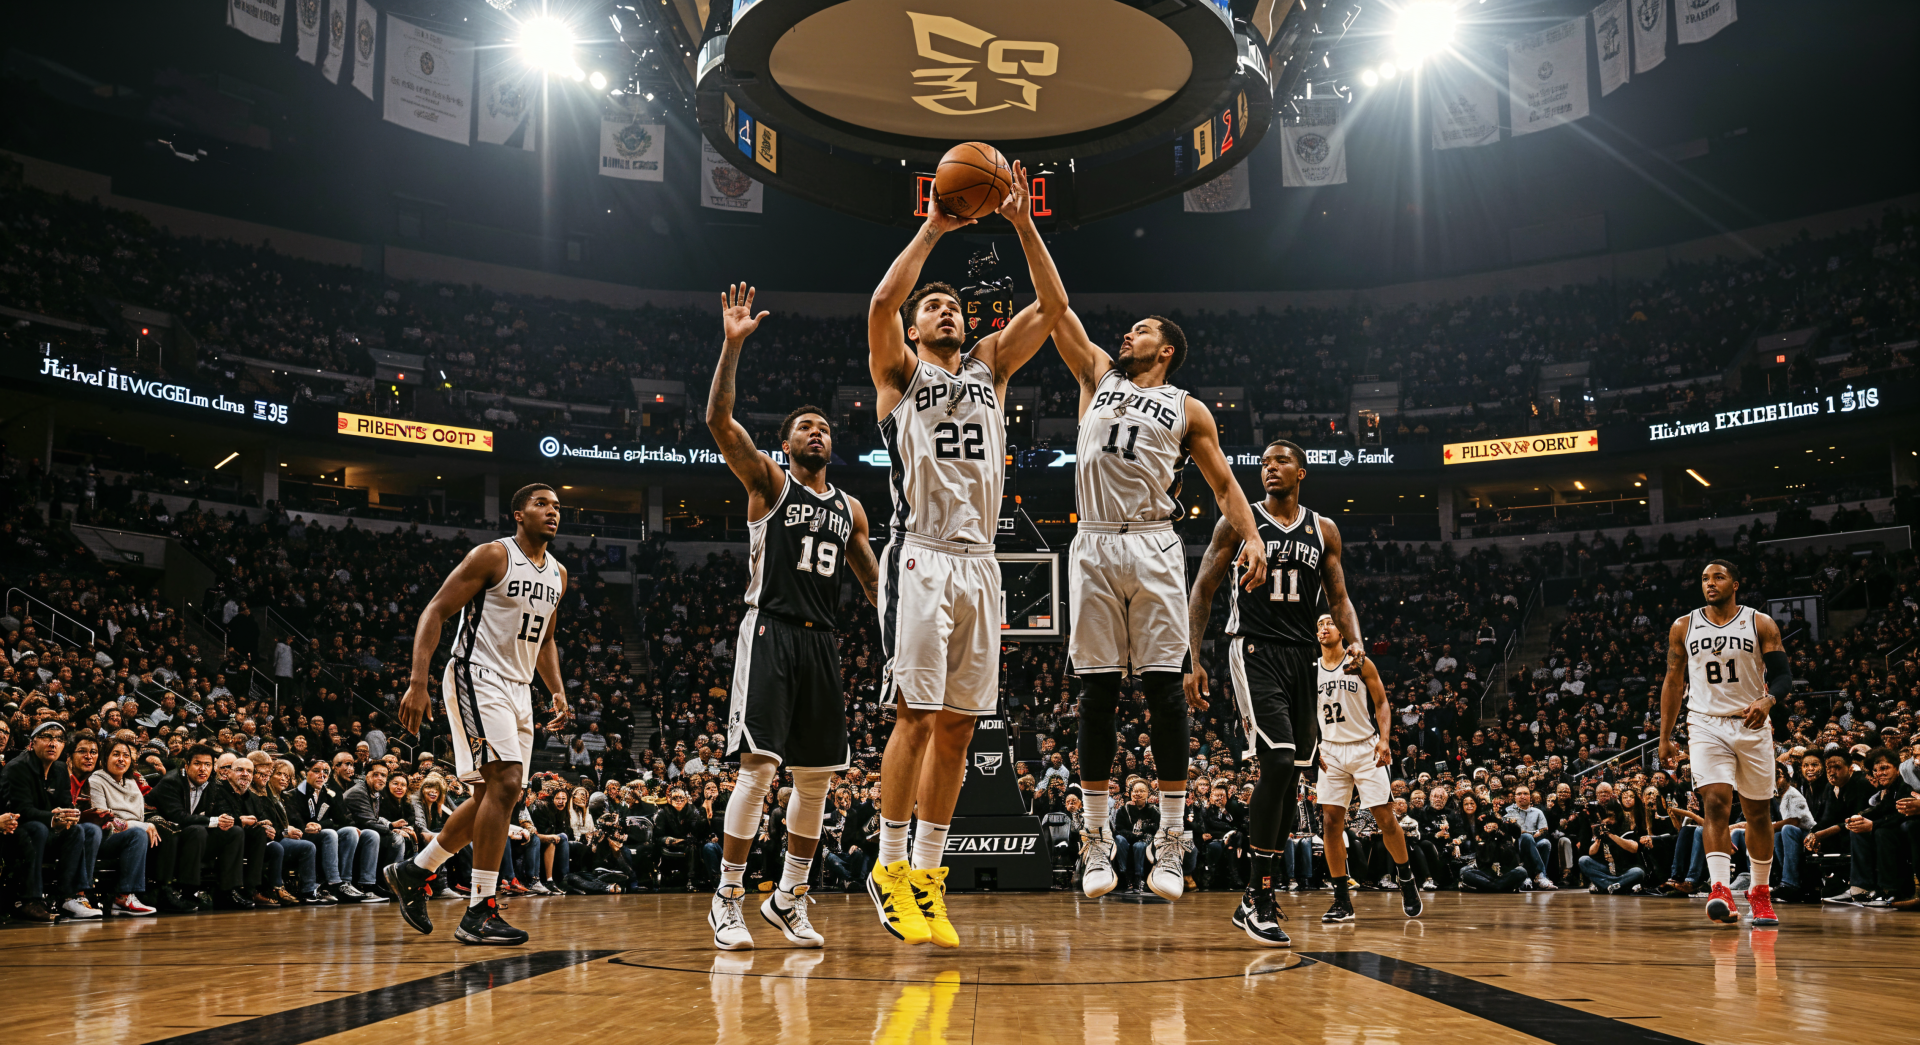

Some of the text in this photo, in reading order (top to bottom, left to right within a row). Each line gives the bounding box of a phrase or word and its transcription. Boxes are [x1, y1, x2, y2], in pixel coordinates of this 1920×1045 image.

[934, 421, 986, 461] 22
[1102, 422, 1140, 461] 11
[1269, 568, 1300, 602] 11
[517, 612, 545, 643] 13
[1705, 658, 1740, 684] 81
[1323, 702, 1346, 725] 22
